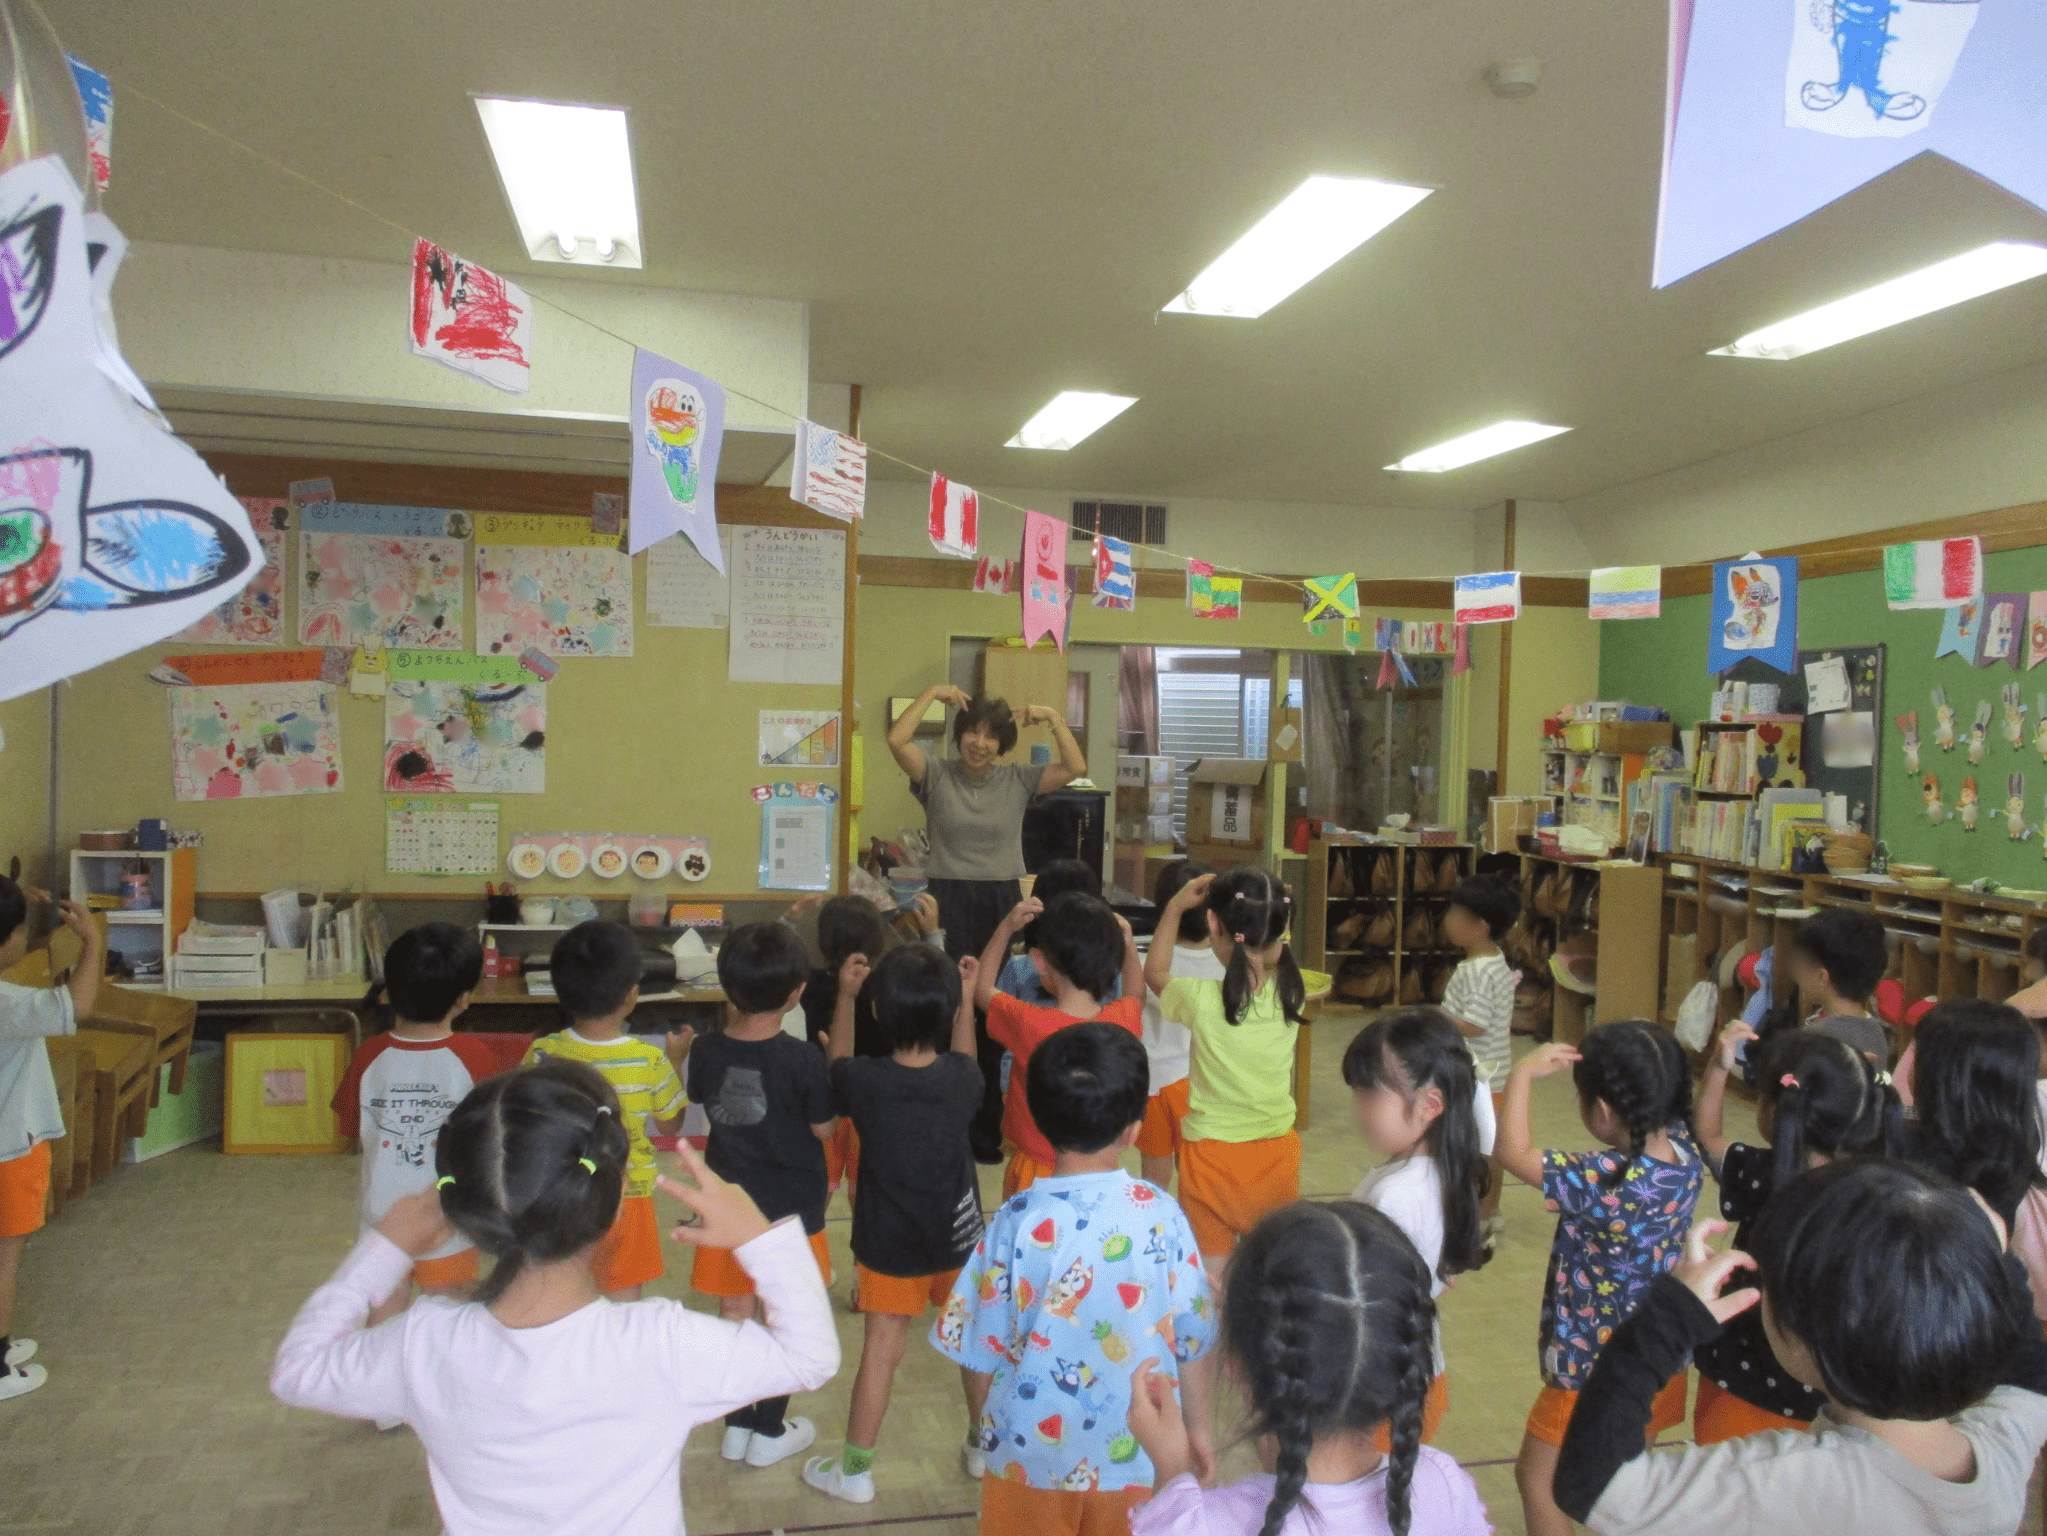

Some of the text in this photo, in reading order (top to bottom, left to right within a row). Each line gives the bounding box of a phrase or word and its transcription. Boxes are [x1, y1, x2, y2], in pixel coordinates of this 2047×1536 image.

[765, 528, 819, 542] うんどうかい
[479, 668, 528, 680] ぐるーぷ
[370, 1098, 388, 1108] SEE
[391, 1099, 405, 1108] IT
[400, 1115, 425, 1124] END
[1098, 1224, 1119, 1244] KIWI
